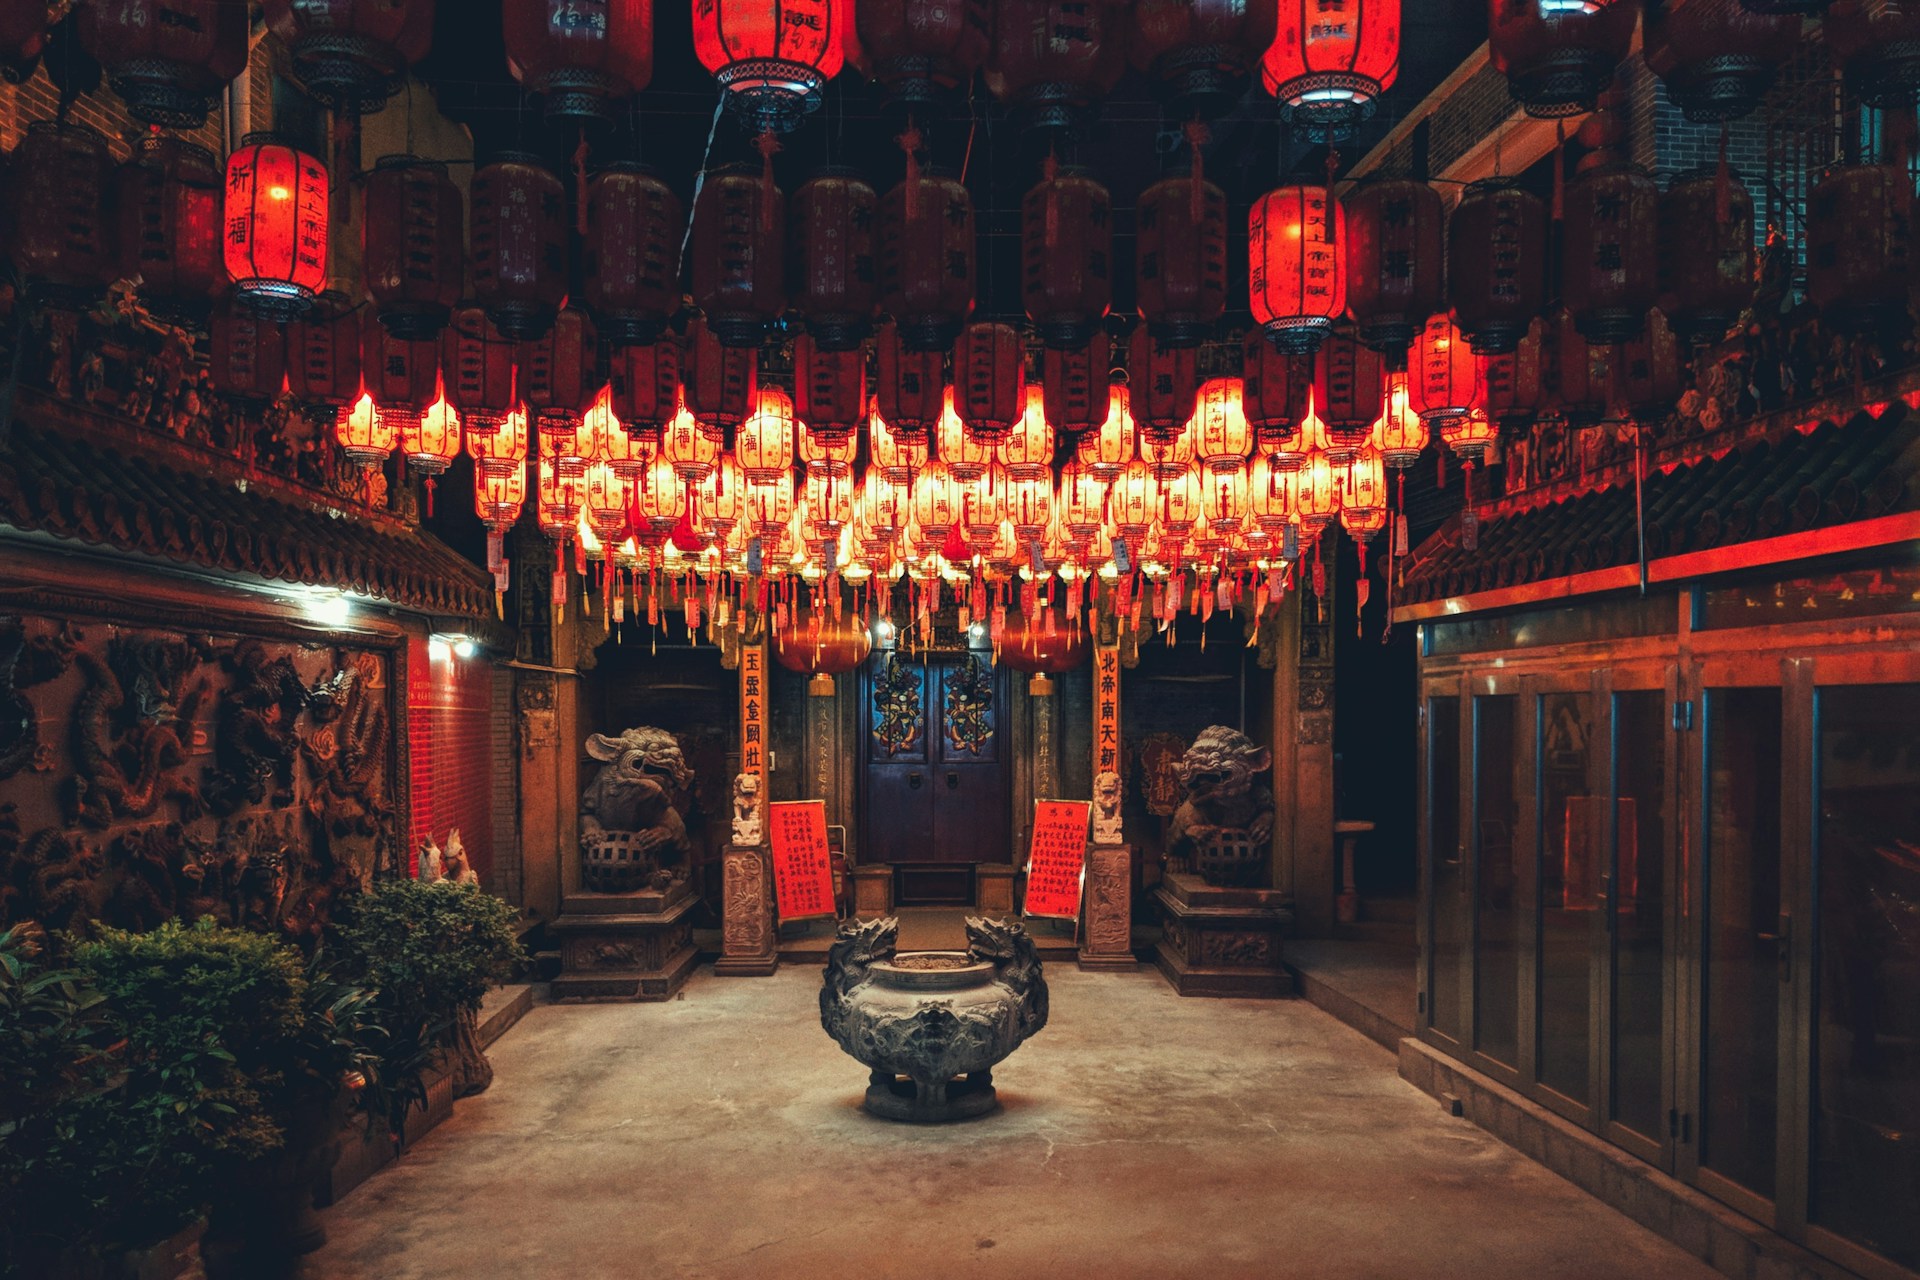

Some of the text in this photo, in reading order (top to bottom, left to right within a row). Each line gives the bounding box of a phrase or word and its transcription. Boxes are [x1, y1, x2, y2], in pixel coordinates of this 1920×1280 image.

[228, 164, 249, 246] 祈福
[1249, 217, 1263, 295] 祈福
[374, 416, 388, 430] 福
[1009, 433, 1023, 449] 福
[744, 434, 757, 453] 福
[1130, 468, 1143, 509] 祈福
[1300, 463, 1312, 500] 祈福
[1360, 455, 1371, 492] 祈福
[935, 475, 948, 513] 祈福
[1172, 494, 1183, 507] 福
[1100, 652, 1116, 774] 北帝南天新
